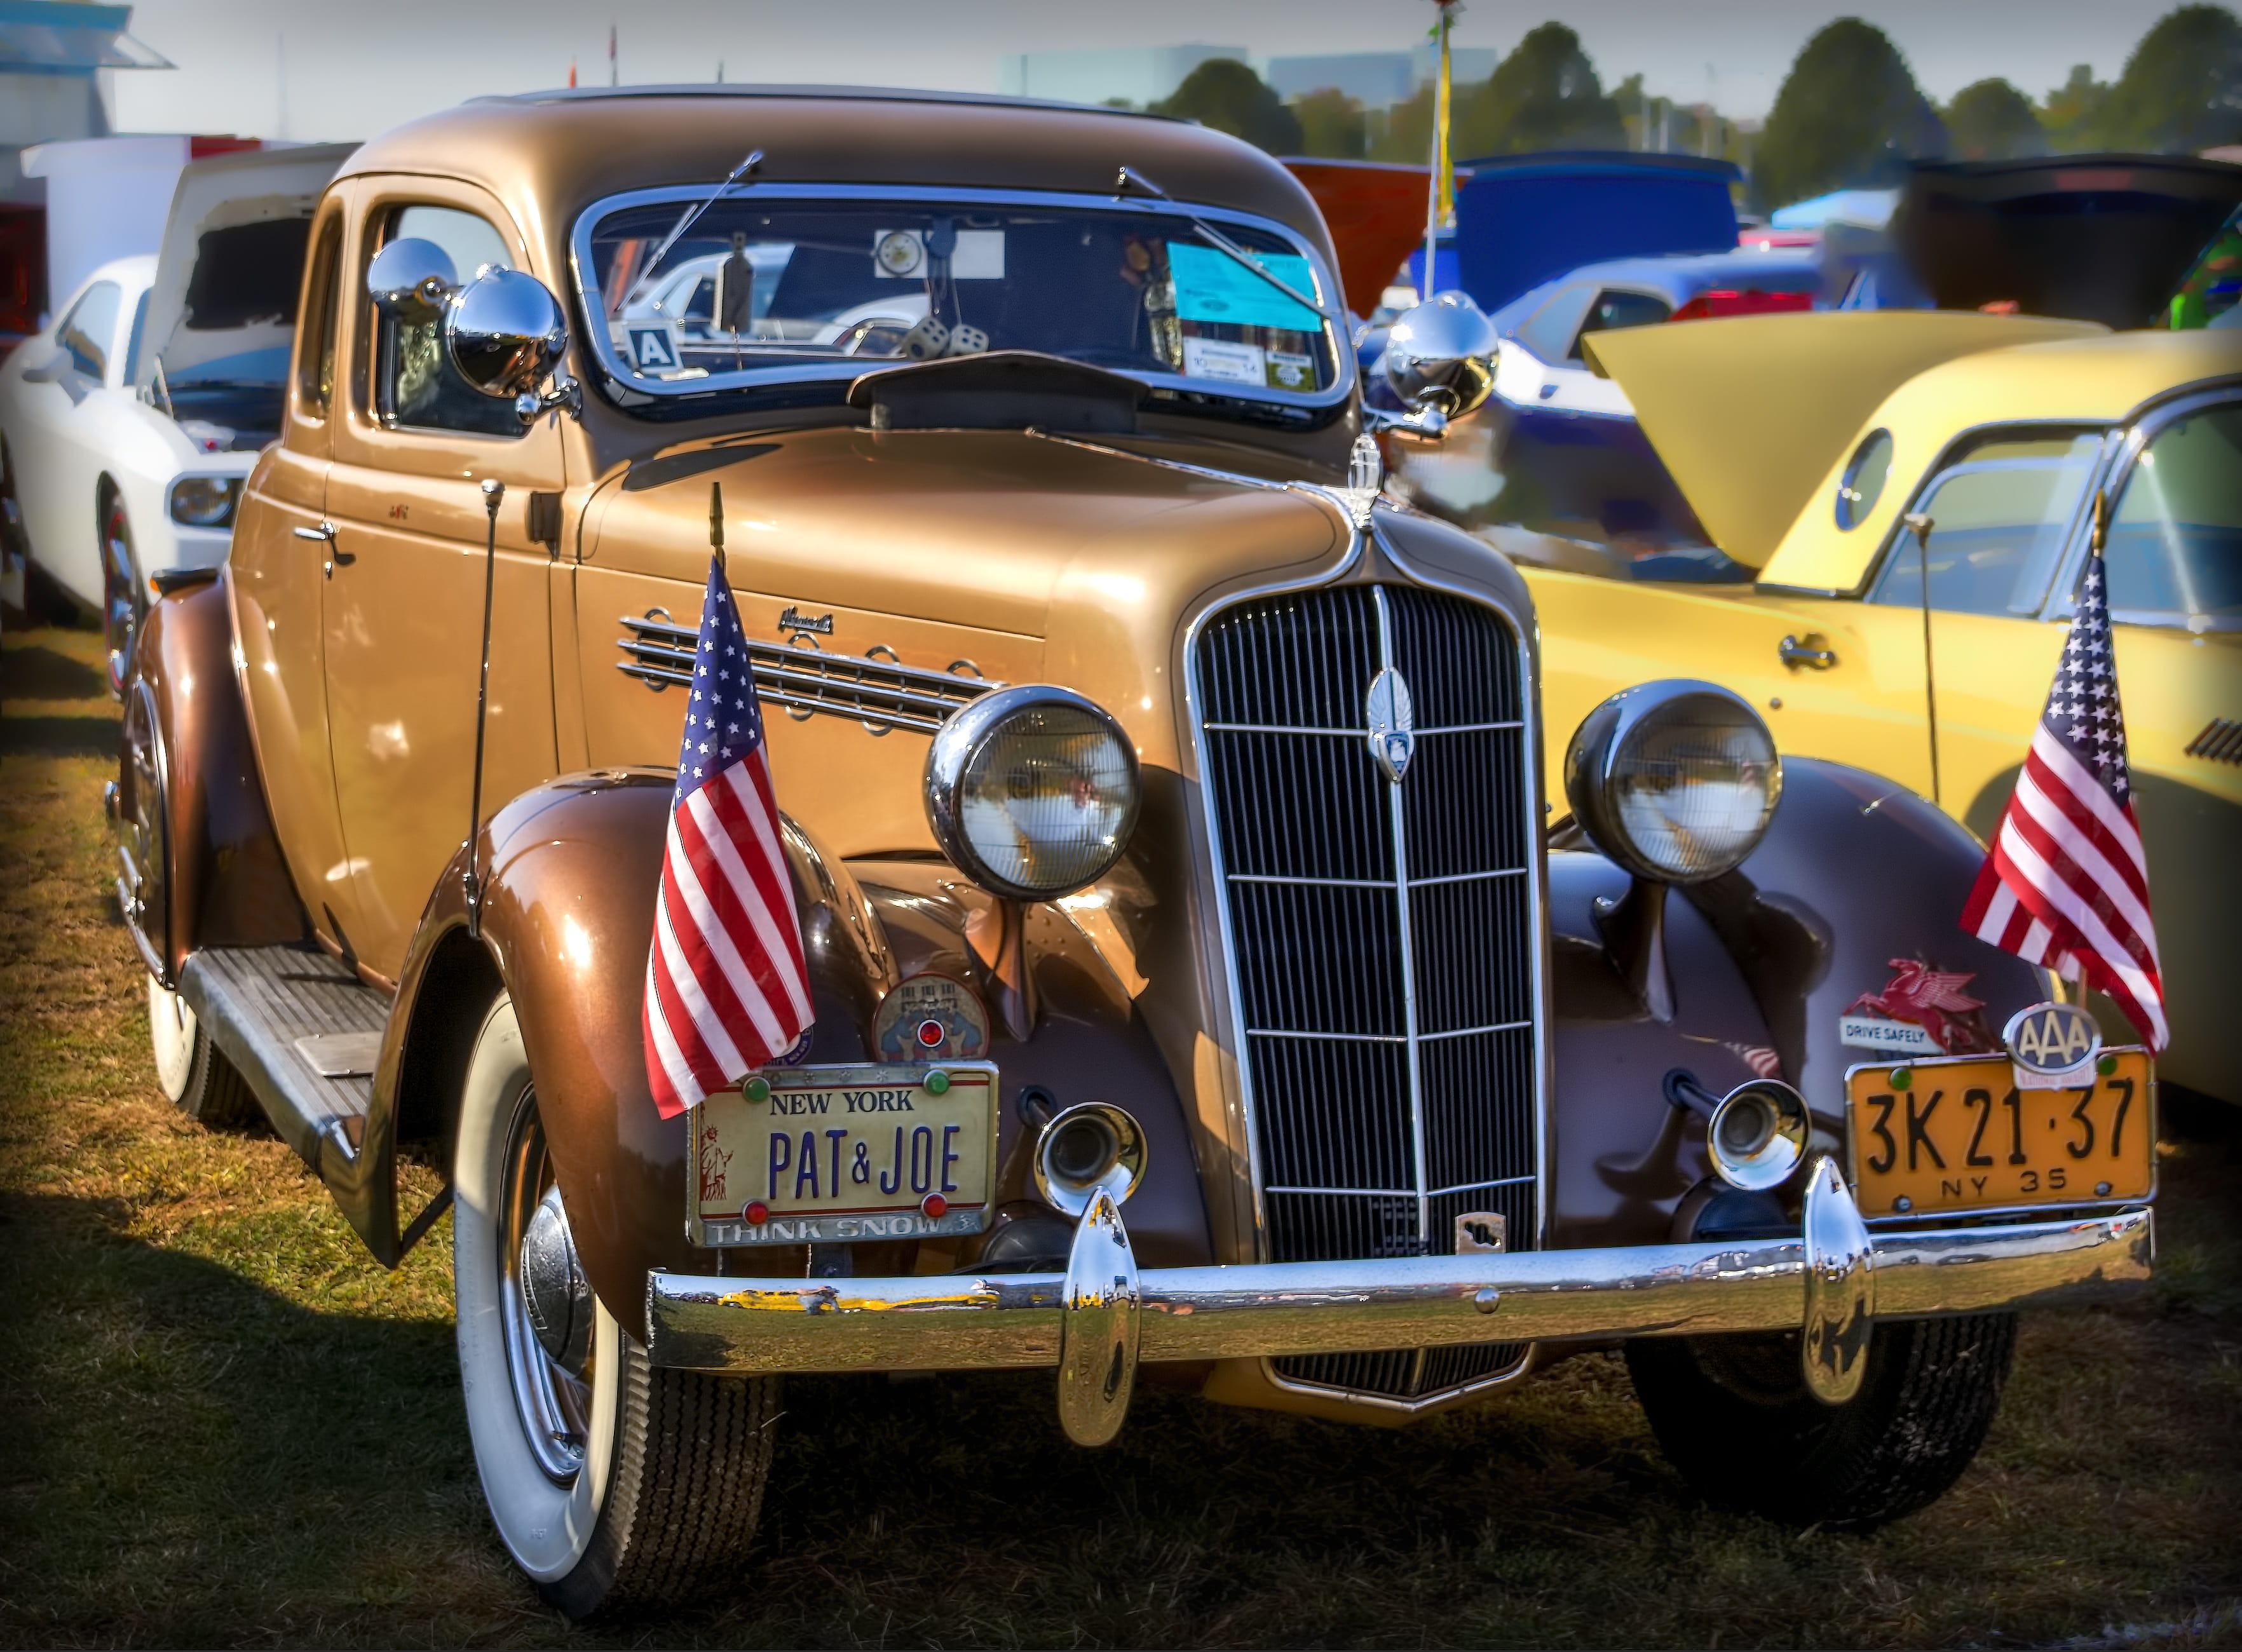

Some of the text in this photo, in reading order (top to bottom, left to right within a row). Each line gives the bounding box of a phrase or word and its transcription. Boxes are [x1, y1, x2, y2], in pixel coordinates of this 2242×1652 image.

[641, 332, 671, 364] A
[1846, 1024, 1925, 1043] DRIVE SAFELY
[2018, 1010, 2090, 1066] AAA
[770, 1090, 914, 1115] NEW YORK
[1943, 1168, 2066, 1197] NY 35
[711, 1216, 942, 1243] THINK SNOW
